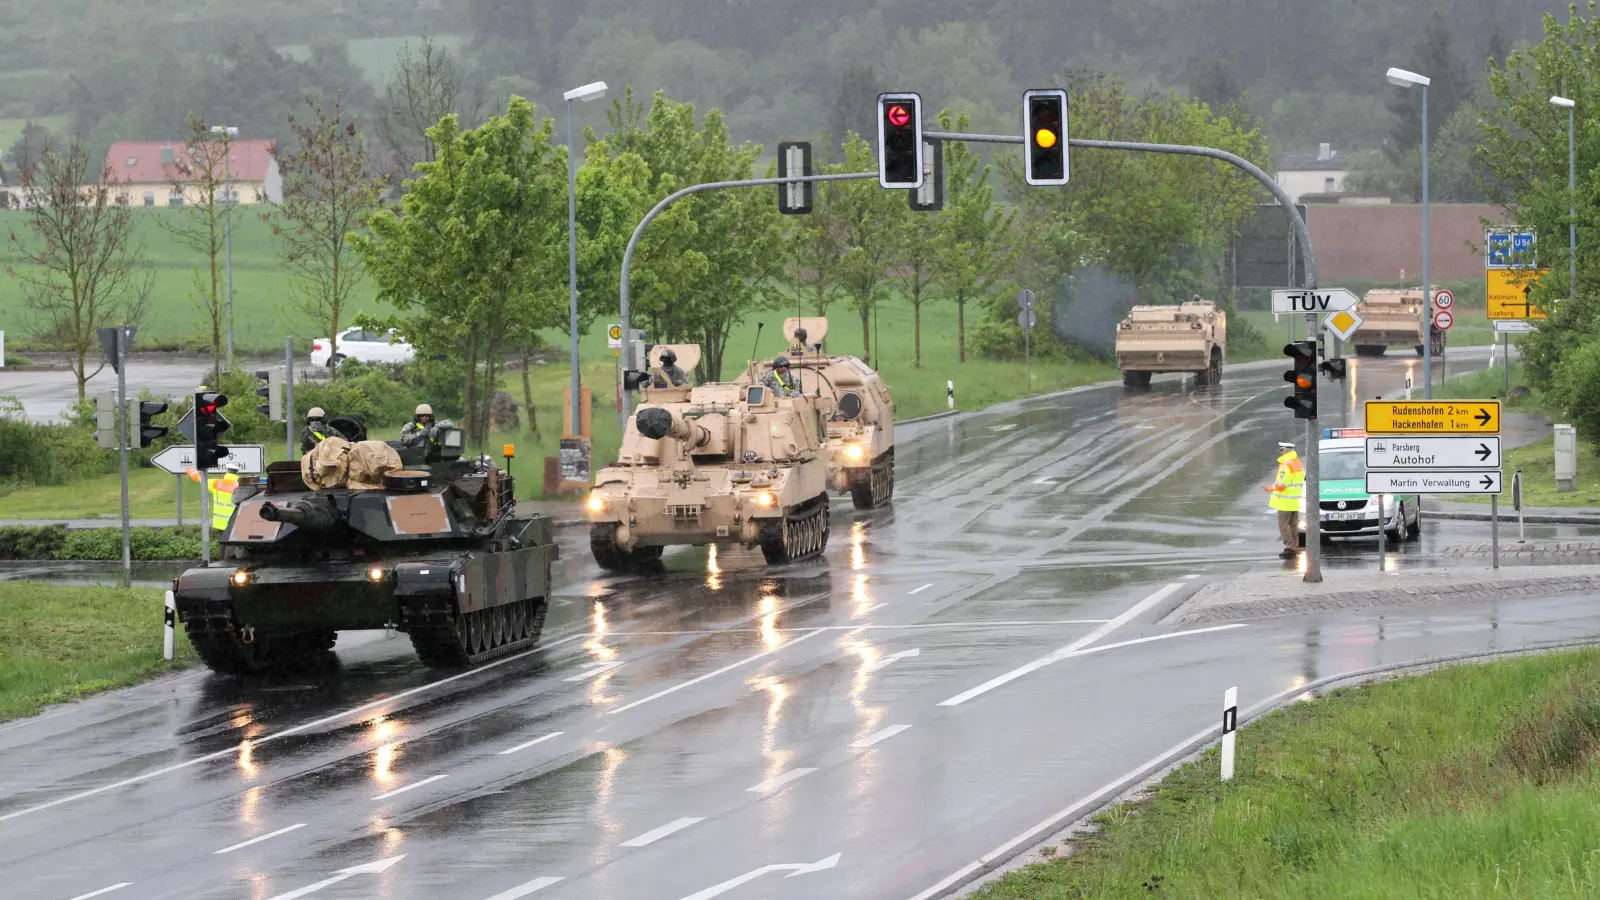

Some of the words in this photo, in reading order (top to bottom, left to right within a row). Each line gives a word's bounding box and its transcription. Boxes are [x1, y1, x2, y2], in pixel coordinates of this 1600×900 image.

[1287, 292, 1331, 311] TÜV
[1438, 295, 1450, 305] 60
[1392, 405, 1444, 415] Rudenshofen
[1447, 405, 1454, 415] 2
[1456, 407, 1469, 415] km
[1392, 419, 1444, 429] Hackenhofen
[1450, 419, 1454, 429] 1
[1392, 443, 1420, 453] Parsberg
[1392, 454, 1436, 465] Autohof
[1390, 478, 1418, 487] Martin
[1422, 478, 1471, 489] Verwaltung
